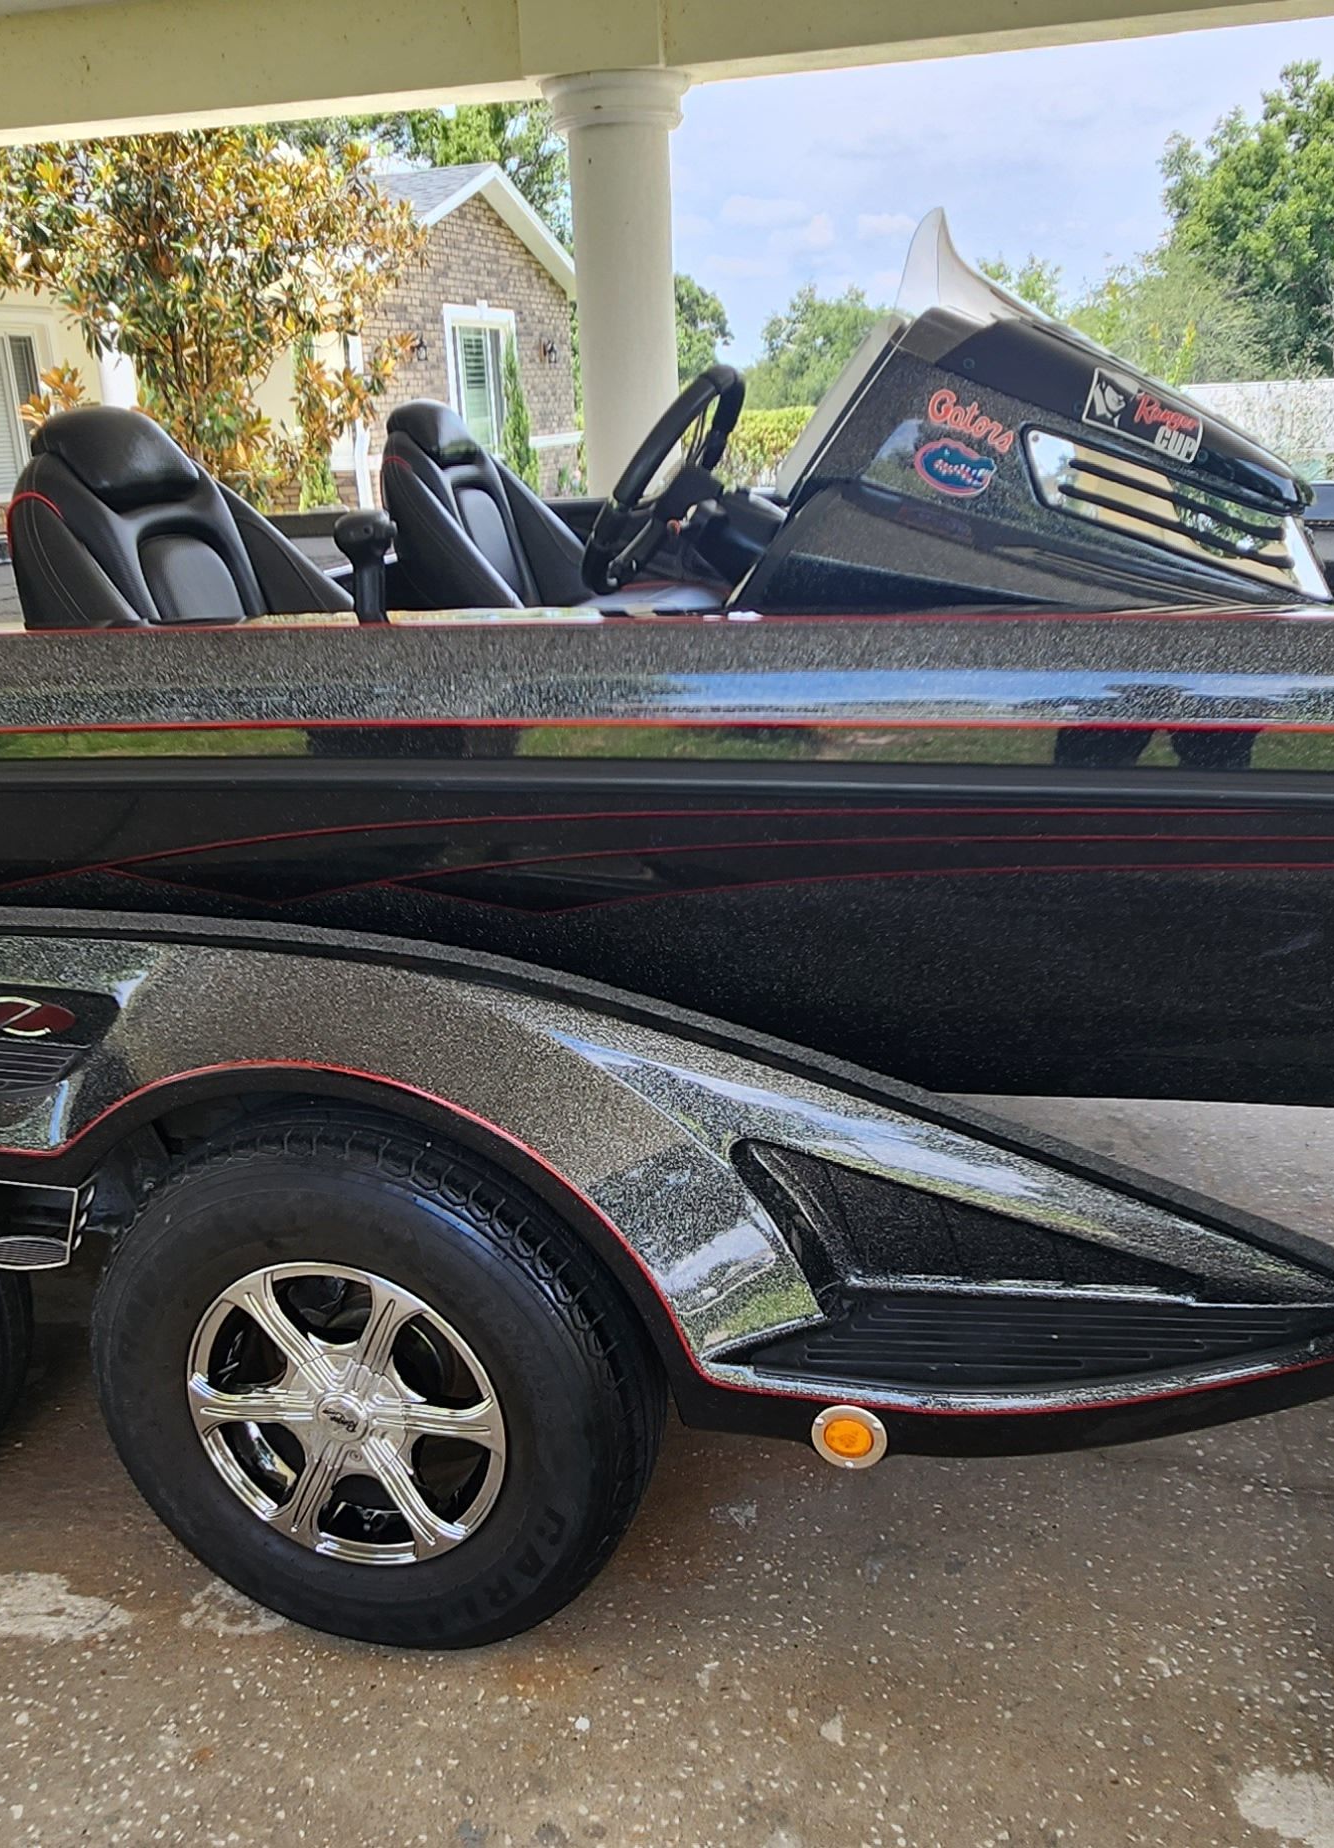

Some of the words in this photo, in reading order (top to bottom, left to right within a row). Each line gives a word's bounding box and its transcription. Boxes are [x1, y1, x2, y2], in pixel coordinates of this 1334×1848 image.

[927, 387, 1015, 453] Gators
[1133, 391, 1199, 432] Ranger
[1154, 425, 1198, 460] CUP
